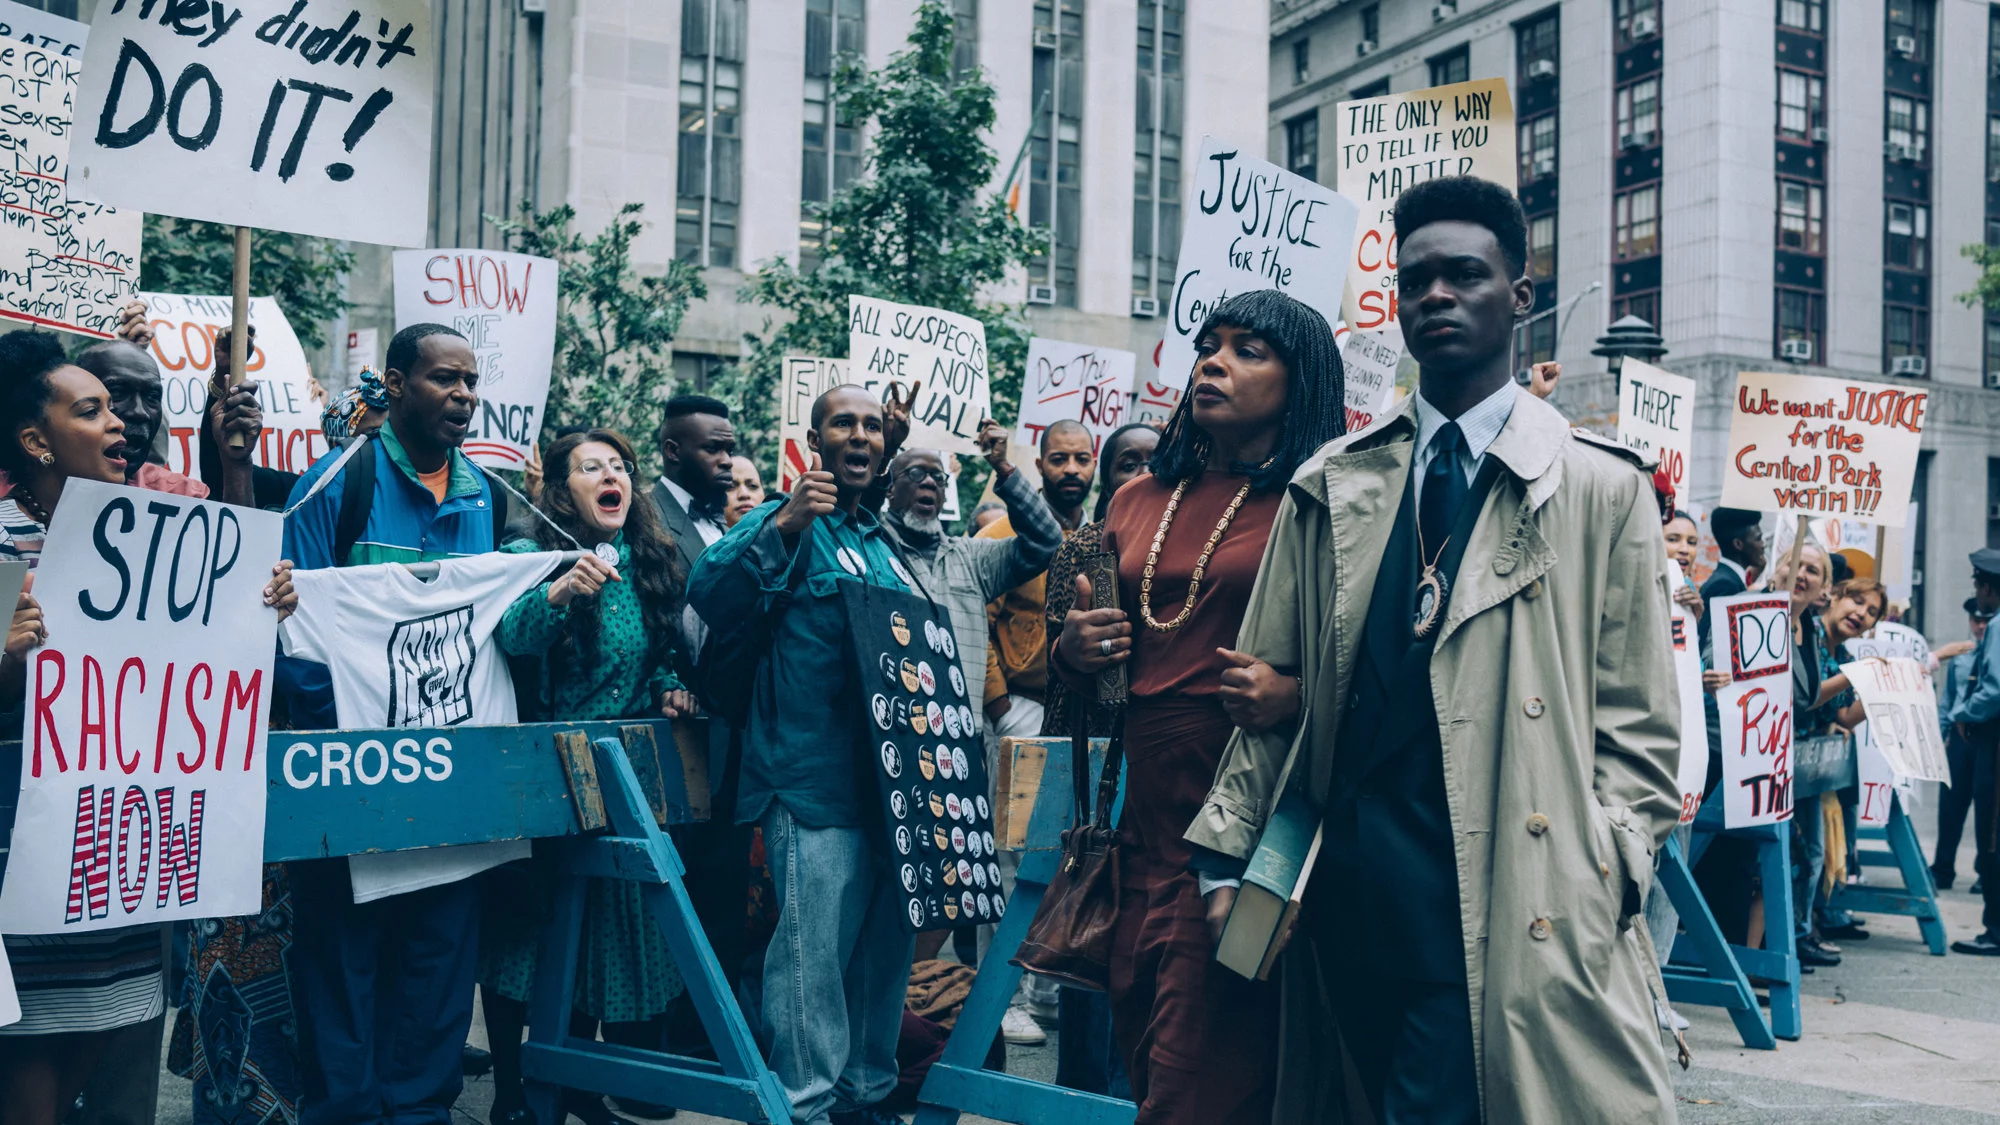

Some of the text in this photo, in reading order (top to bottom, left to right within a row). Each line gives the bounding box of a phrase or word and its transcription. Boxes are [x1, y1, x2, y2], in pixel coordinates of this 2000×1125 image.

[111, 0, 243, 48] ey
[255, 0, 416, 68] didn't
[95, 37, 393, 183] DO IT!
[1348, 91, 1492, 136] THE ONLY WAY
[1343, 126, 1488, 169] TO TELL IF YOU
[0, 169, 60, 199] sboro
[26, 248, 104, 282] Boston
[87, 237, 134, 270] More
[1262, 246, 1292, 289] the
[42, 275, 118, 306] Justice
[423, 255, 532, 314] SHOW
[454, 314, 502, 350] ME
[850, 304, 984, 372] ALL SUSPECTS
[868, 346, 984, 400] ARE NOT
[1630, 379, 1682, 432] THERE
[1739, 385, 1928, 433] We want JUSTICE
[1788, 420, 1864, 453] for the
[1659, 446, 1683, 484] NO
[1735, 444, 1882, 488] Central Park
[78, 497, 241, 626] STOP
[1738, 611, 1787, 669] DO
[31, 649, 263, 778] RACISM
[282, 737, 453, 789] CROSS
[64, 784, 206, 924] NOW
